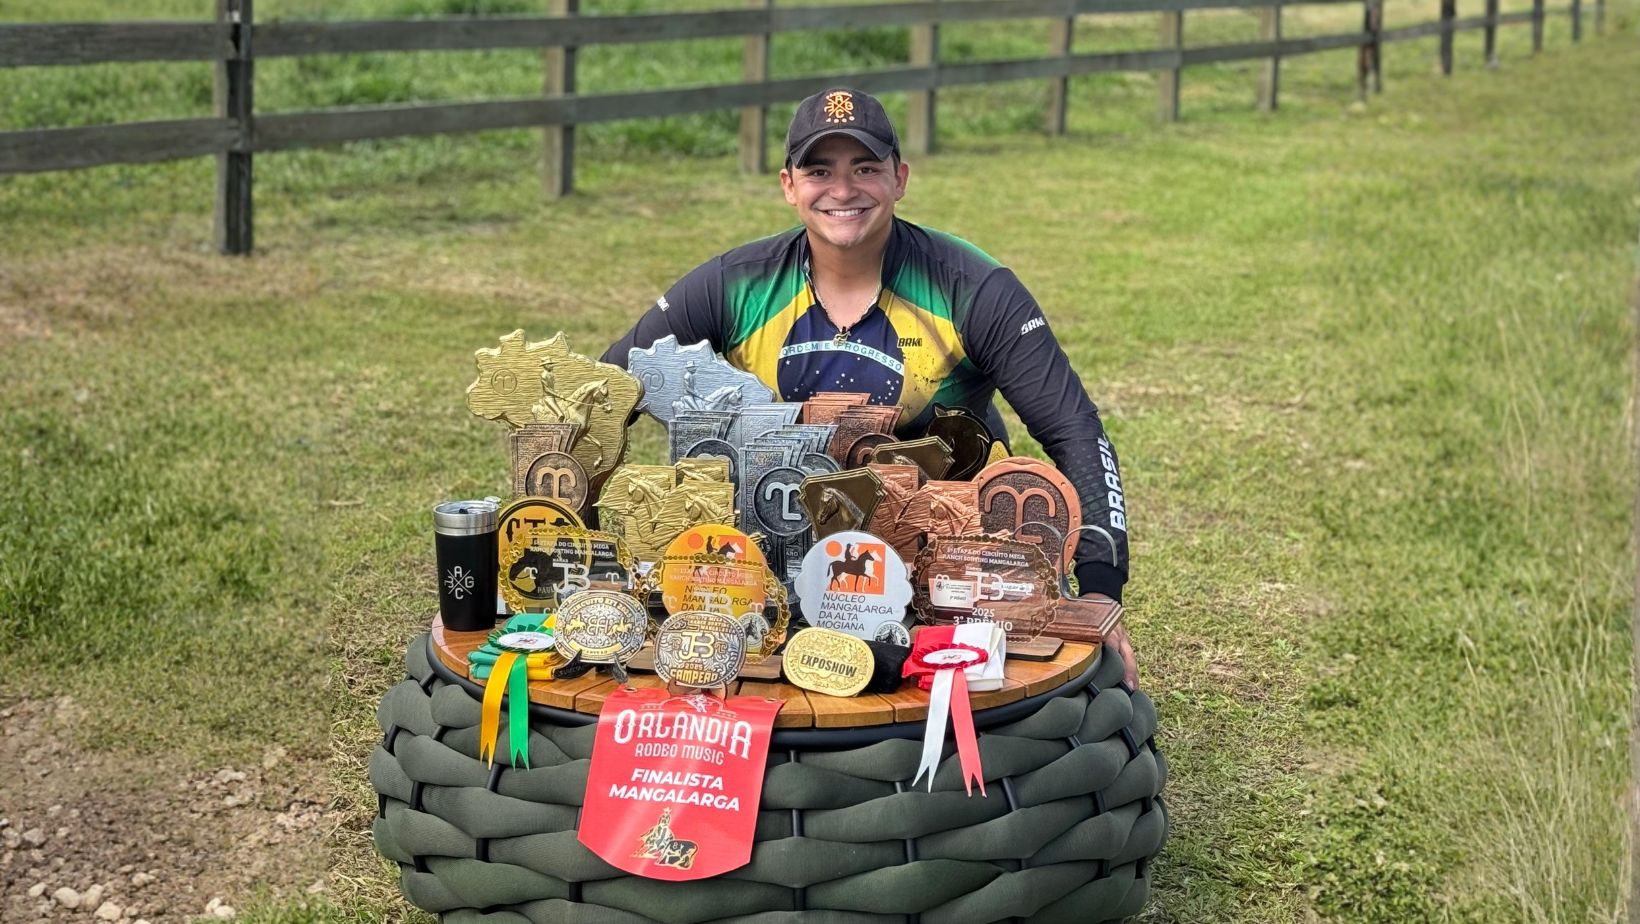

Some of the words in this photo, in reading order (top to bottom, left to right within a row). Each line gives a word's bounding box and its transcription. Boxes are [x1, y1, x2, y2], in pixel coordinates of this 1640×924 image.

[782, 341, 819, 356] ORDEM
[824, 342, 831, 350] E
[836, 341, 902, 372] PROGRESSO
[1097, 432, 1127, 532] BRASIL
[988, 558, 1029, 567] MANGALARGA
[569, 597, 604, 614] CIRCUITO
[822, 591, 866, 603] NÚCLEO
[818, 611, 833, 619] DA
[834, 612, 859, 621] ALTA
[820, 602, 893, 615] MANGALARGA
[972, 607, 995, 617] 2025
[816, 620, 865, 631] MOGIANA
[800, 654, 858, 677] EXPOSHOW
[634, 742, 677, 758] RODEO
[681, 744, 725, 766] MUSIC
[631, 768, 724, 790] FINALISTA
[608, 783, 740, 812] MANGALARGA
